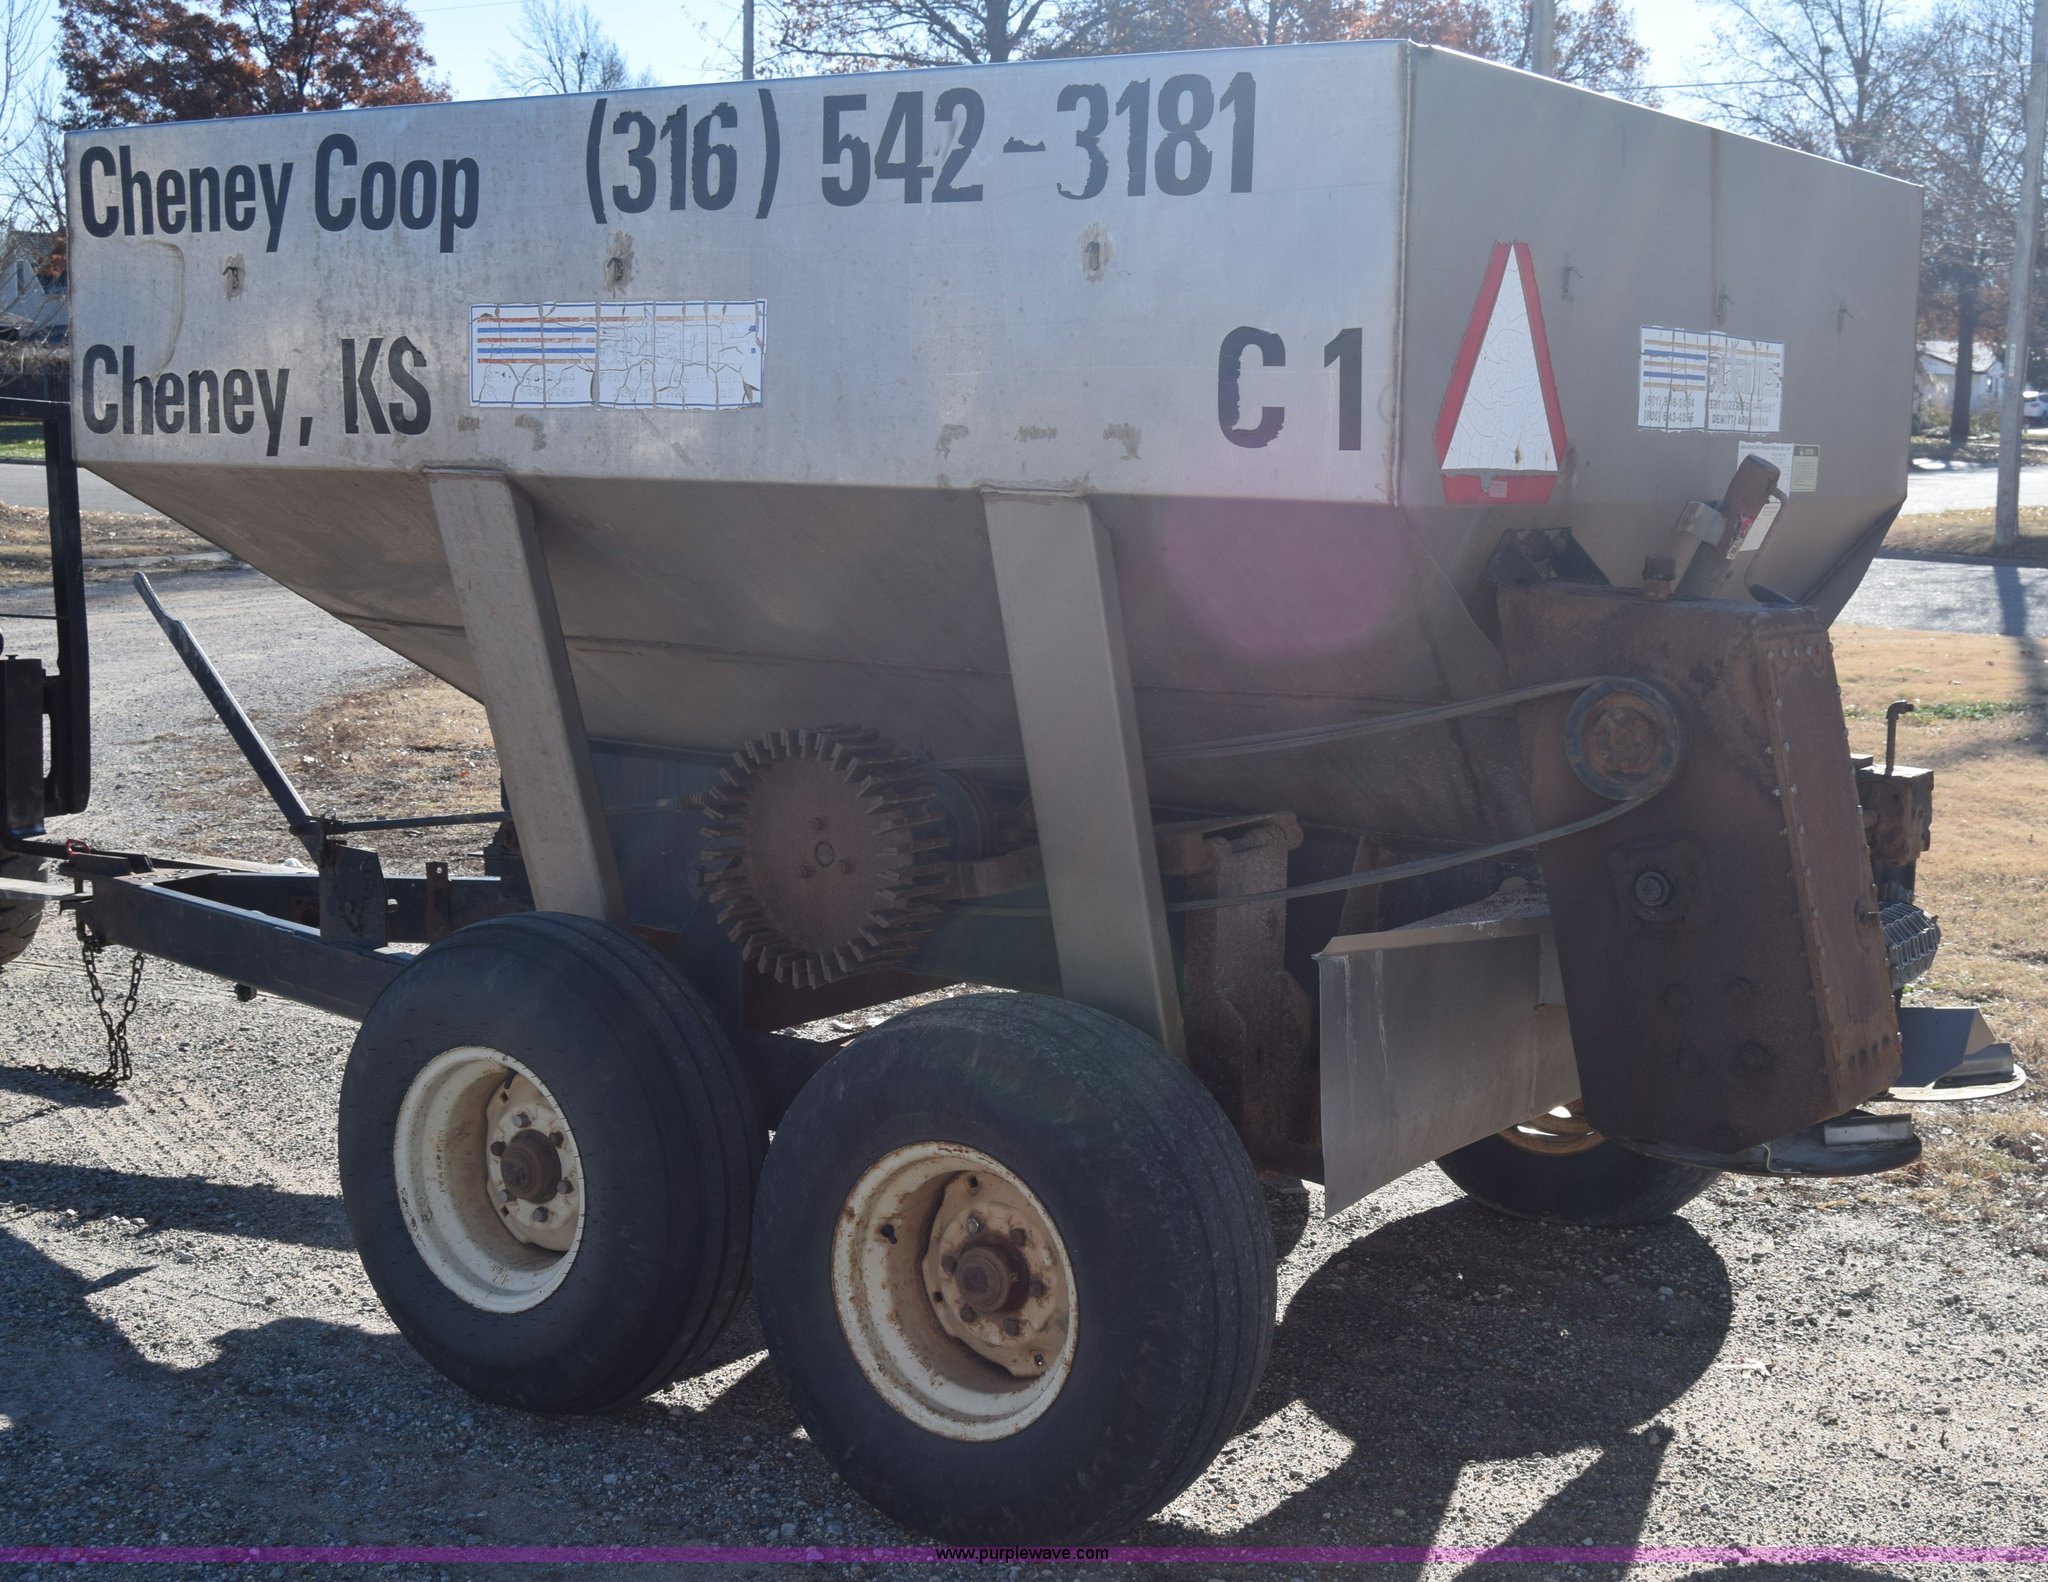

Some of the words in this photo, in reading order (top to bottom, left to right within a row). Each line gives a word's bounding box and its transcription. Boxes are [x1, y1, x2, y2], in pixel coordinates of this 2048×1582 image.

[79, 145, 294, 253] Cheney
[314, 133, 480, 253] Coop
[586, 88, 781, 224] (316)
[82, 344, 313, 457] Cheney,
[341, 336, 432, 436] KS
[1217, 325, 1286, 449] C
[1323, 327, 1363, 451] 1
